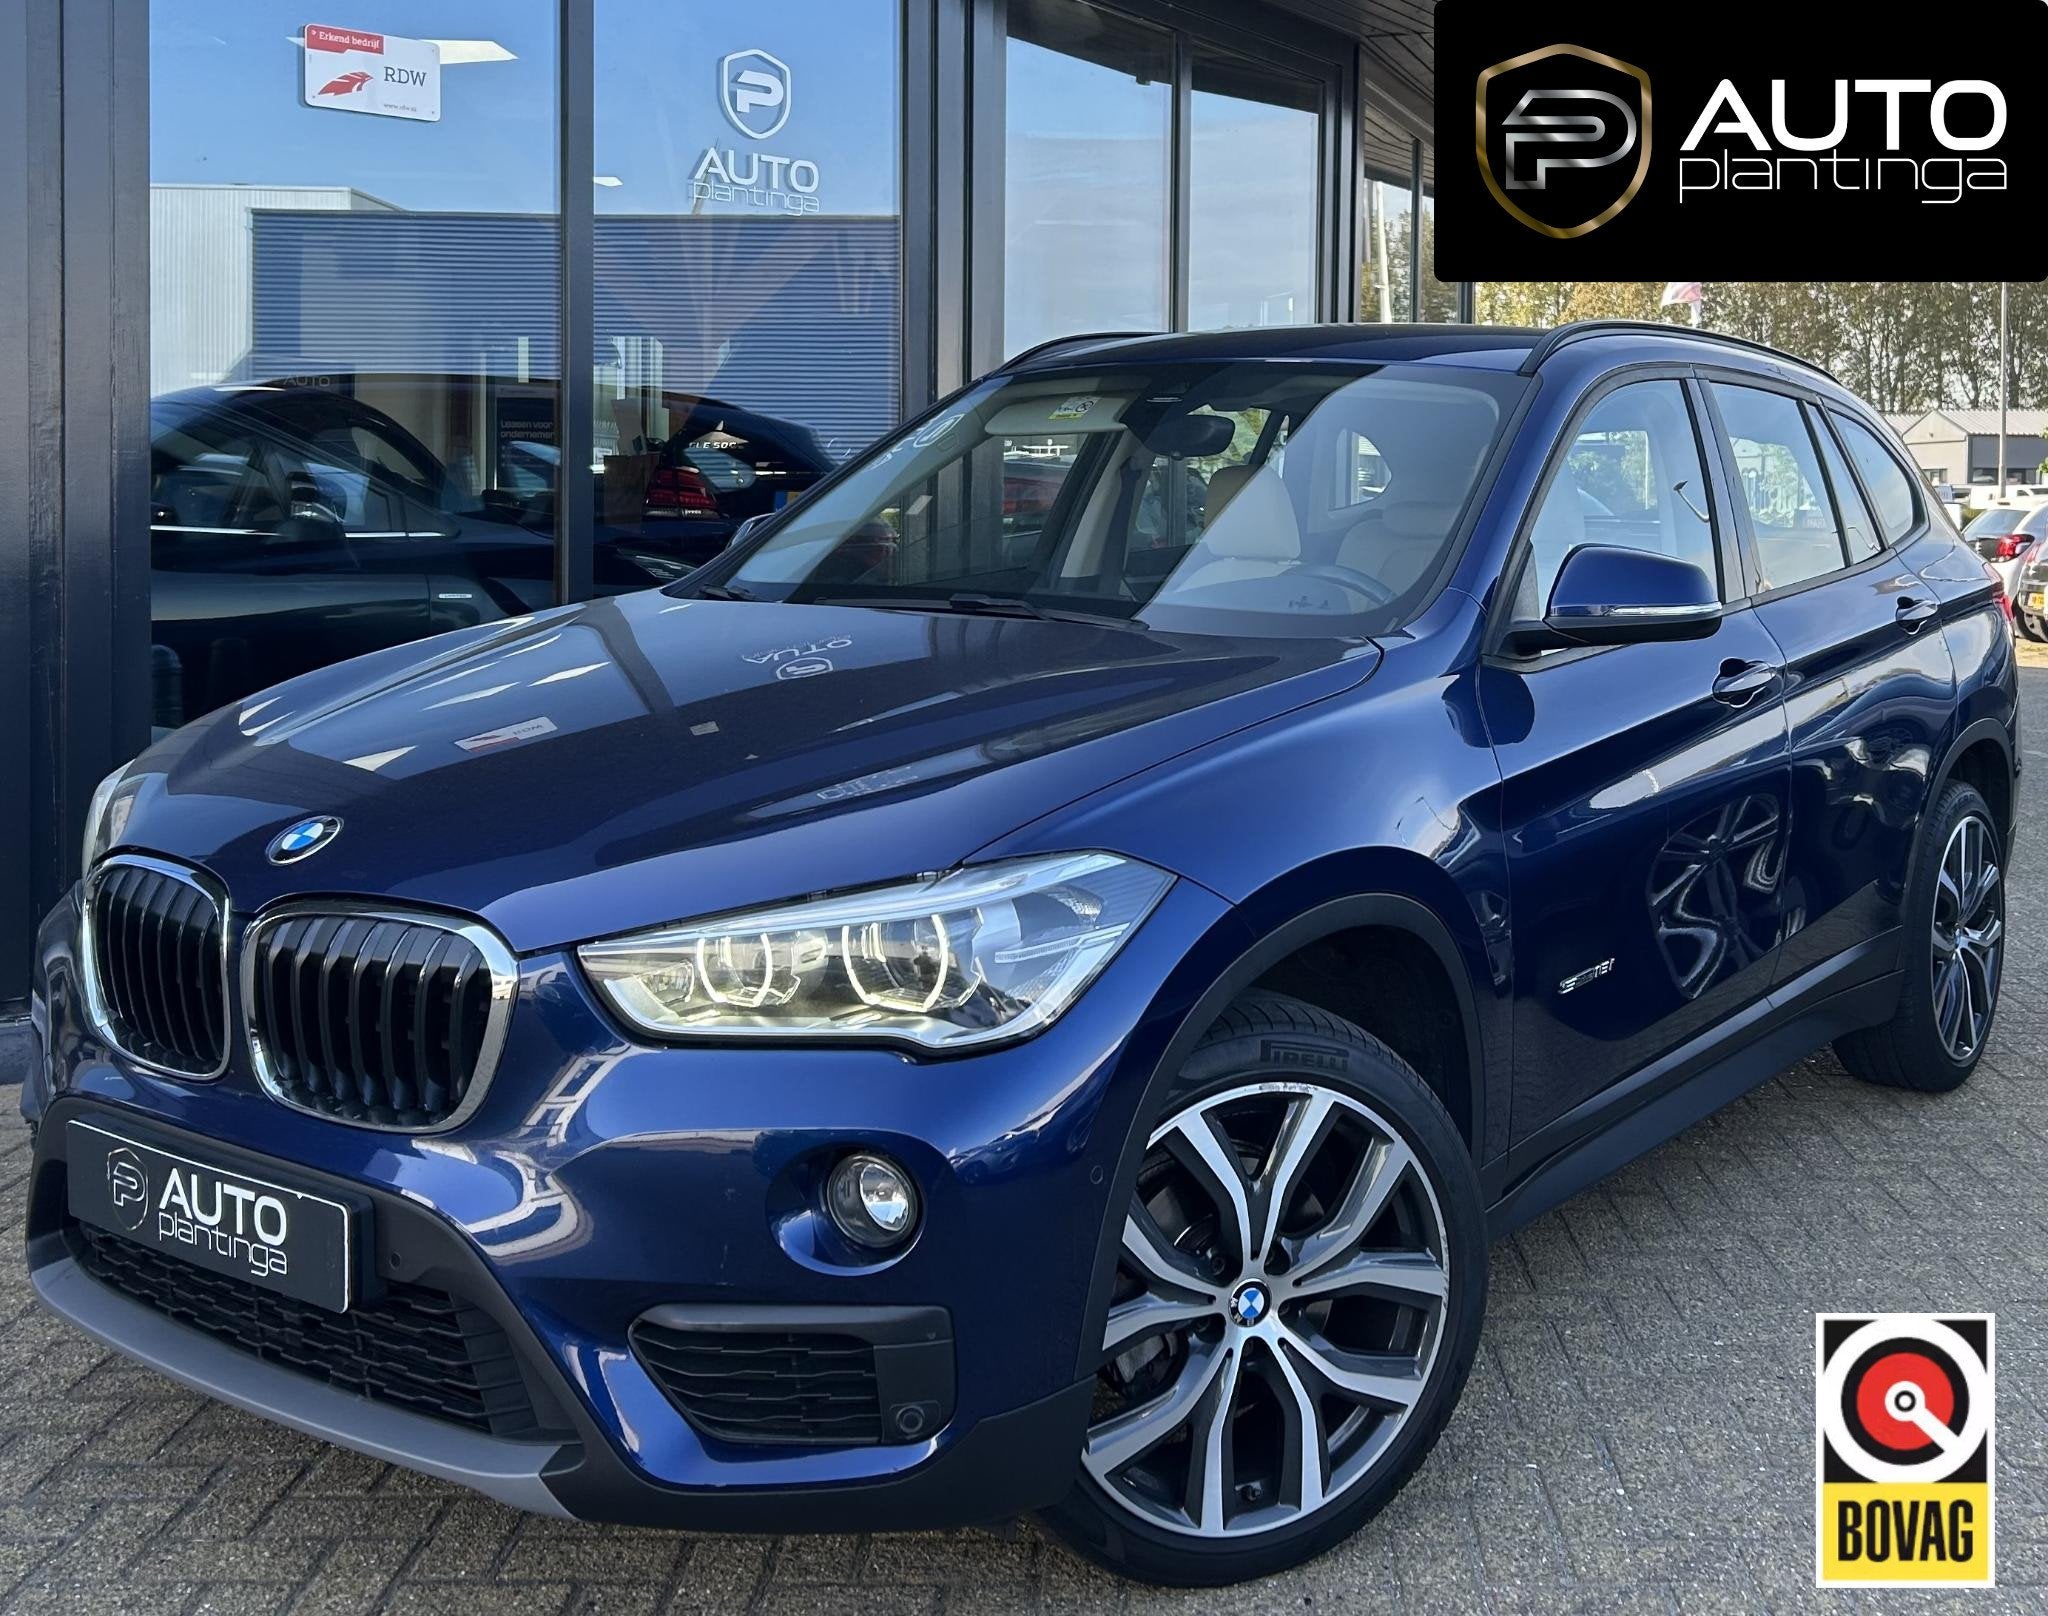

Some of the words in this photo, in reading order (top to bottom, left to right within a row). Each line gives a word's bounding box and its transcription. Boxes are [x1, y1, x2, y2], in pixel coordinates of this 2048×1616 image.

[319, 31, 350, 44] Erkend
[352, 36, 380, 49] bedrijf
[384, 66, 427, 87] RDW
[694, 147, 819, 193] AUTO
[693, 180, 820, 216] plantinga
[1261, 1040, 1350, 1073] PIRELLI
[159, 1167, 287, 1246] AUTO
[159, 1211, 287, 1277] plantinga
